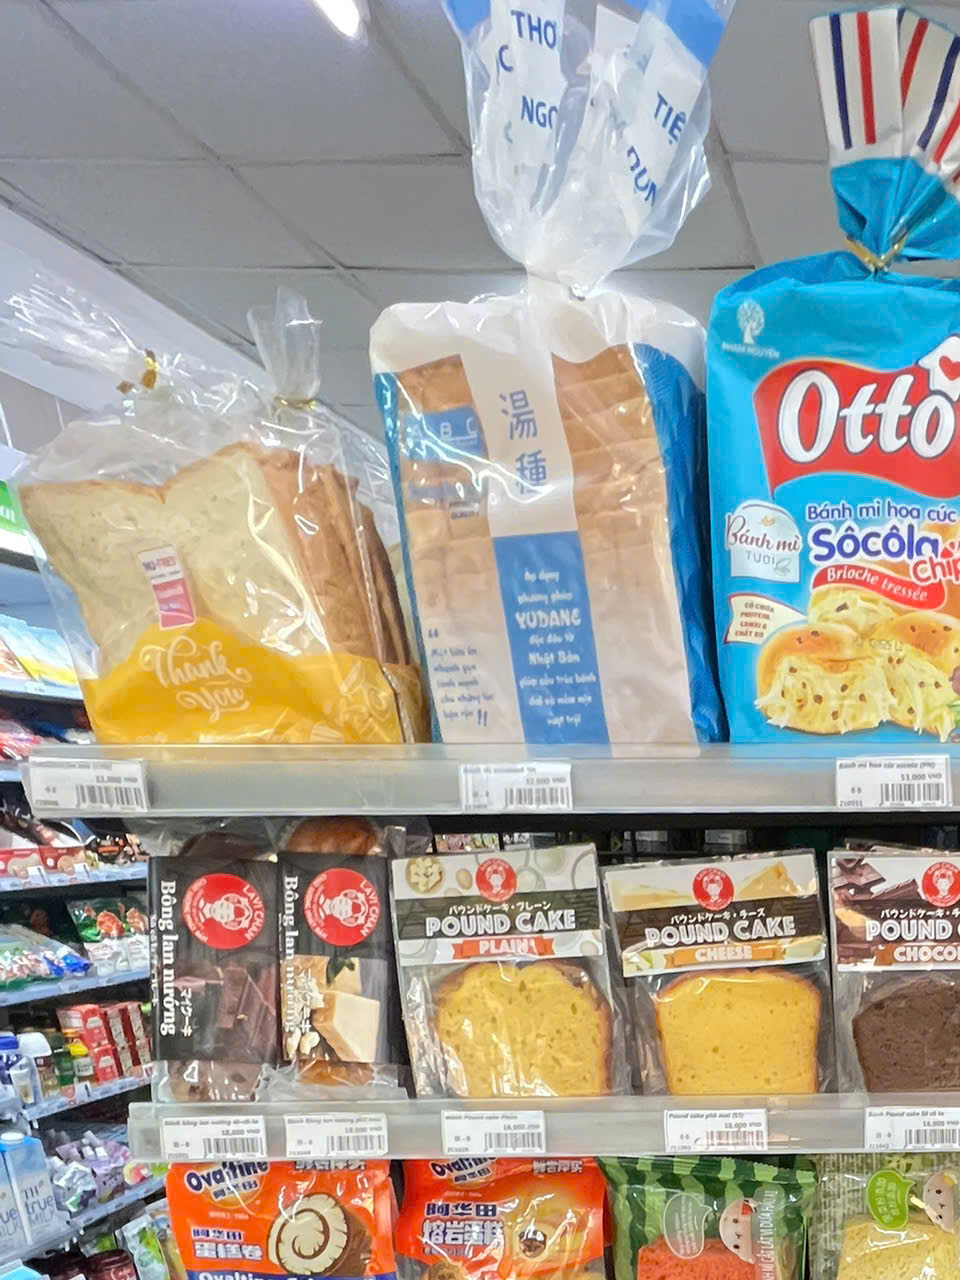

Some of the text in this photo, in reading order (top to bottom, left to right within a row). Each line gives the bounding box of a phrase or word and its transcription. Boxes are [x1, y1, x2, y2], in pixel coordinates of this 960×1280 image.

[778, 369, 956, 463] Otto
[806, 500, 957, 524] Bánh mì hoa cúc
[811, 526, 940, 562] Sôcôla
[158, 880, 178, 931] Bông
[283, 875, 299, 928] Bông
[425, 909, 576, 938] POUND CAKE
[645, 916, 797, 948] POUND CAKE
[865, 919, 953, 942] POUND
[161, 934, 179, 965] lan
[285, 929, 299, 961] lan
[477, 937, 528, 956] PLAIN
[694, 944, 754, 962] CHEESE
[185, 1161, 270, 1192] Ovaltine
